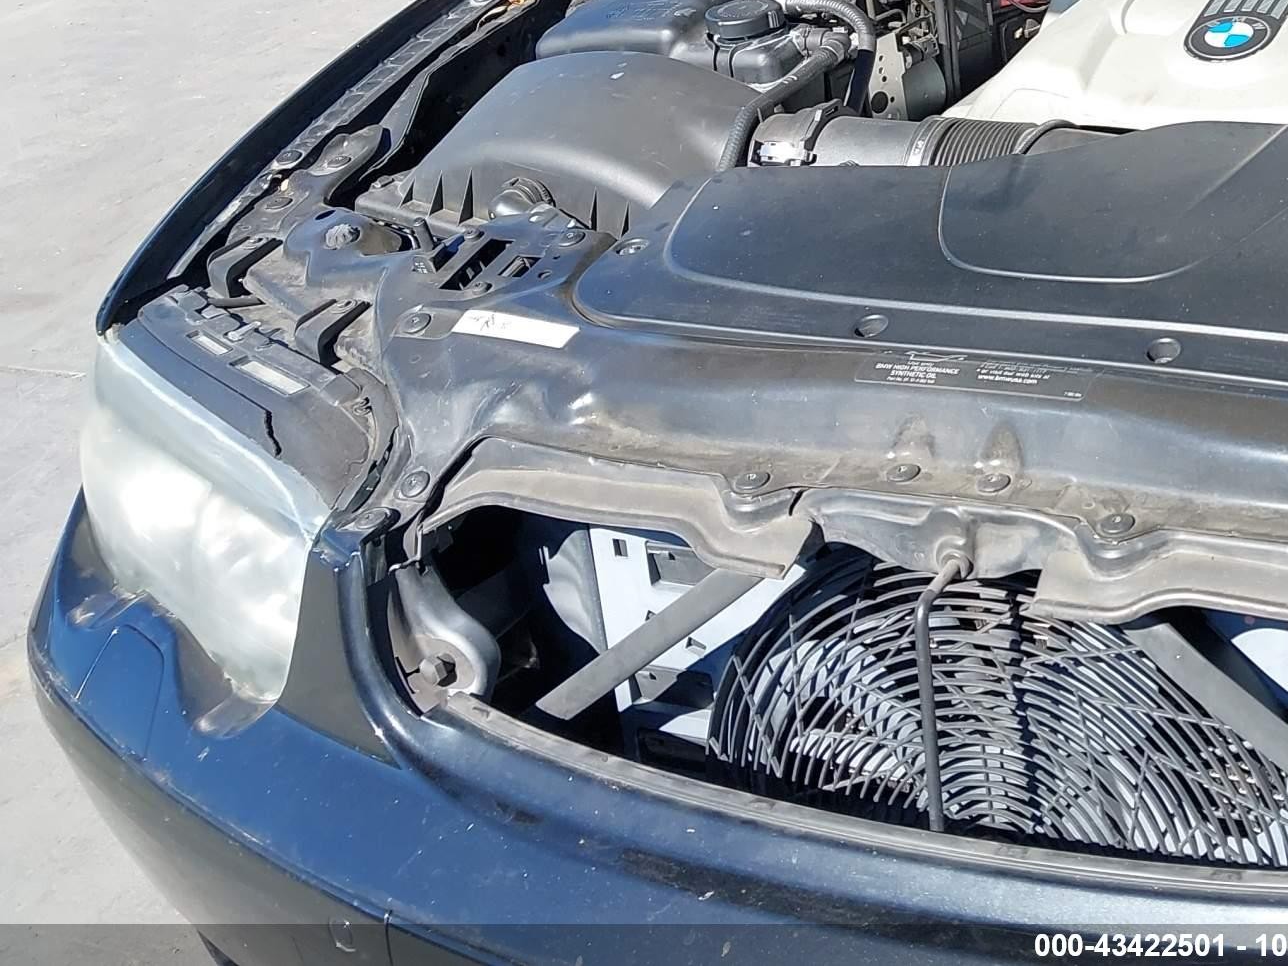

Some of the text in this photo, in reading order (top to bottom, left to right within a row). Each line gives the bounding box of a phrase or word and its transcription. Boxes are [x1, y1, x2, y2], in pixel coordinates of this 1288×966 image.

[875, 362, 893, 370] BMW
[910, 365, 960, 375] PERFORMANCE
[890, 370, 926, 378] SYNTHETIC
[977, 374, 1038, 384] www.bmwusa.com
